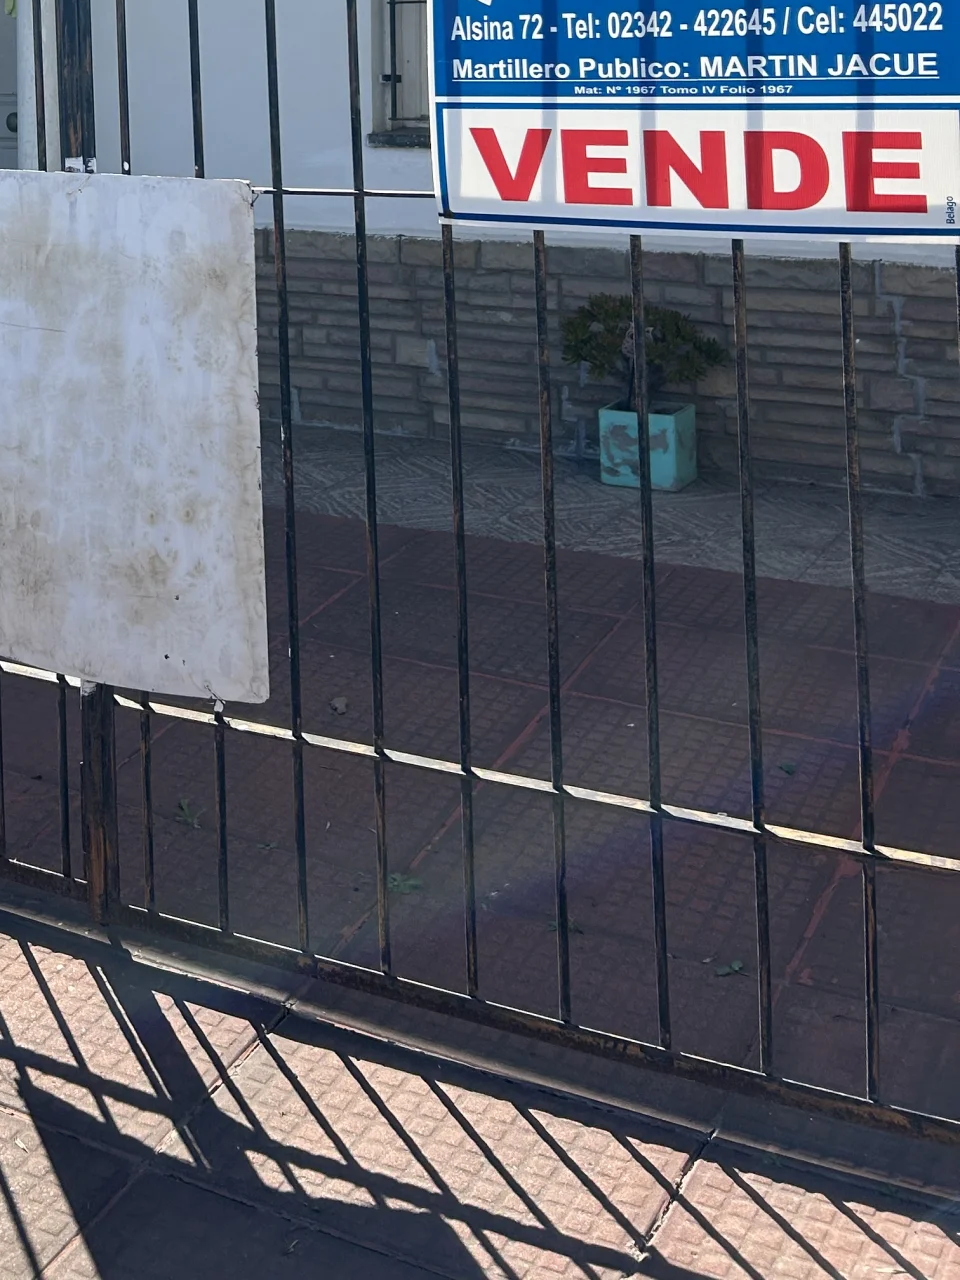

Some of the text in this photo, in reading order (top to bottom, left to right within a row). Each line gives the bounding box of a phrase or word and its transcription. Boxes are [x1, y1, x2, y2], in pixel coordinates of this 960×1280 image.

[451, 15, 514, 41] Alsina
[518, 14, 544, 40] 72
[562, 12, 601, 39] Tel:
[607, 10, 673, 38] 02342
[693, 7, 776, 37] 422645
[782, 6, 790, 36] /
[797, 5, 845, 35] Cel:
[852, 1, 943, 33] 445022
[452, 52, 939, 79] Martillero Publico: MARTIN JACUE
[574, 85, 603, 95] Mat:
[625, 85, 657, 95] 1967
[659, 85, 699, 95] Tomo
[702, 85, 716, 94] IV
[719, 85, 756, 94] Folio
[760, 84, 793, 94] 1967
[469, 127, 928, 215] VENDE
[946, 195, 957, 225] Belago
